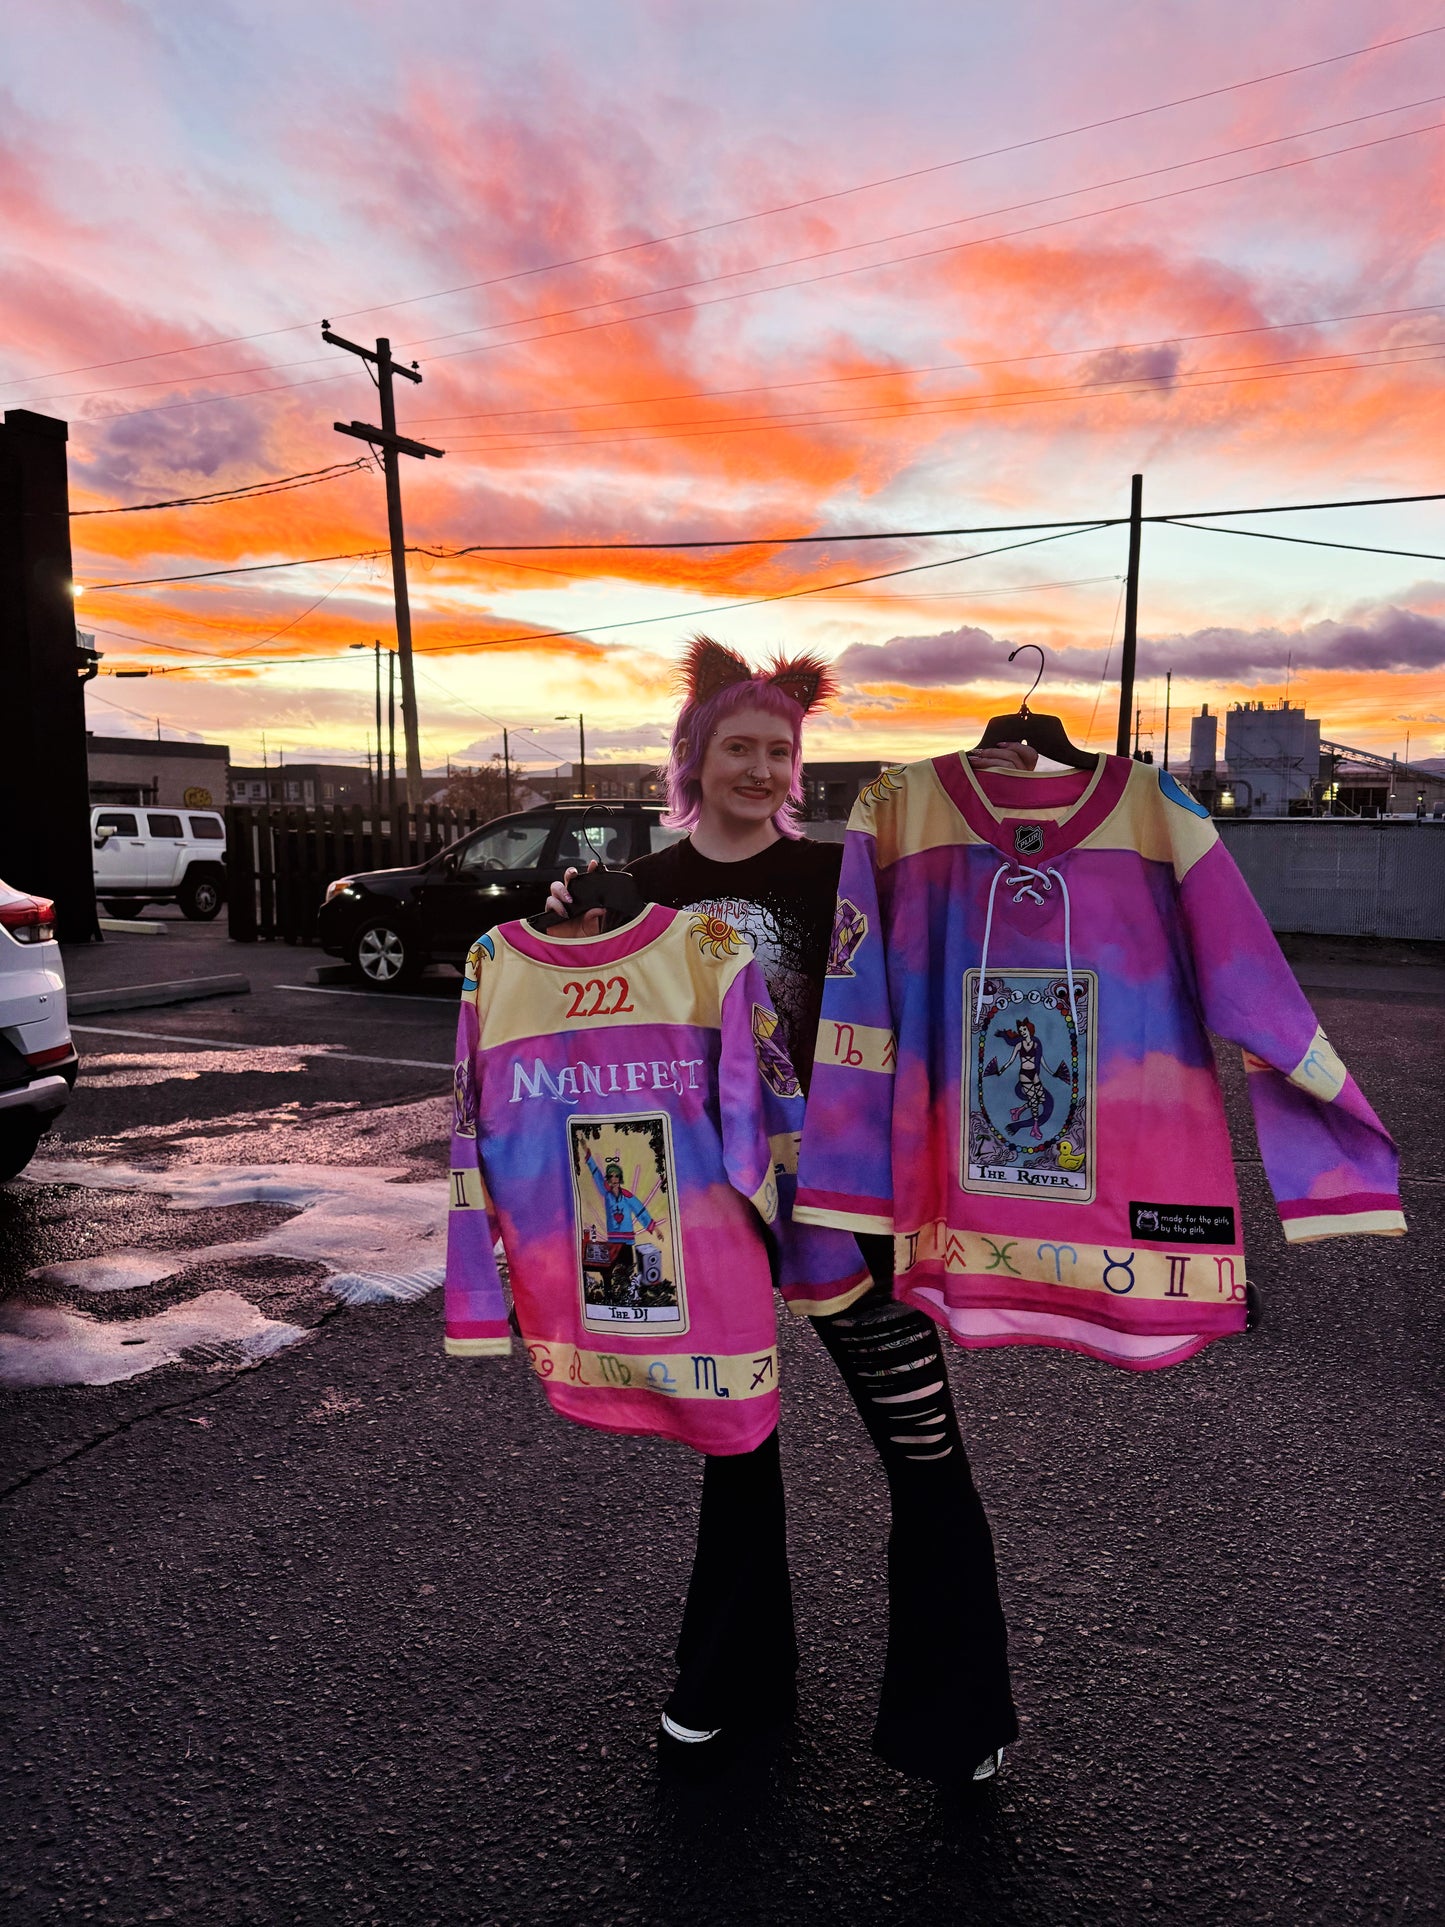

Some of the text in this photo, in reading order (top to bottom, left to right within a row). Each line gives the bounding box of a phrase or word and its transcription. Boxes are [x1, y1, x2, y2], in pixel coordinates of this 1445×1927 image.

[1020, 832, 1039, 848] PLUR
[563, 976, 634, 1019] 222
[997, 992, 1055, 1009] PLUR
[509, 1058, 703, 1104] MANIFEST
[977, 1165, 1007, 1180] THE
[1161, 1214, 1230, 1226] made for the girls
[1160, 1225, 1205, 1236] by the girls
[632, 1308, 649, 1321] DJ
